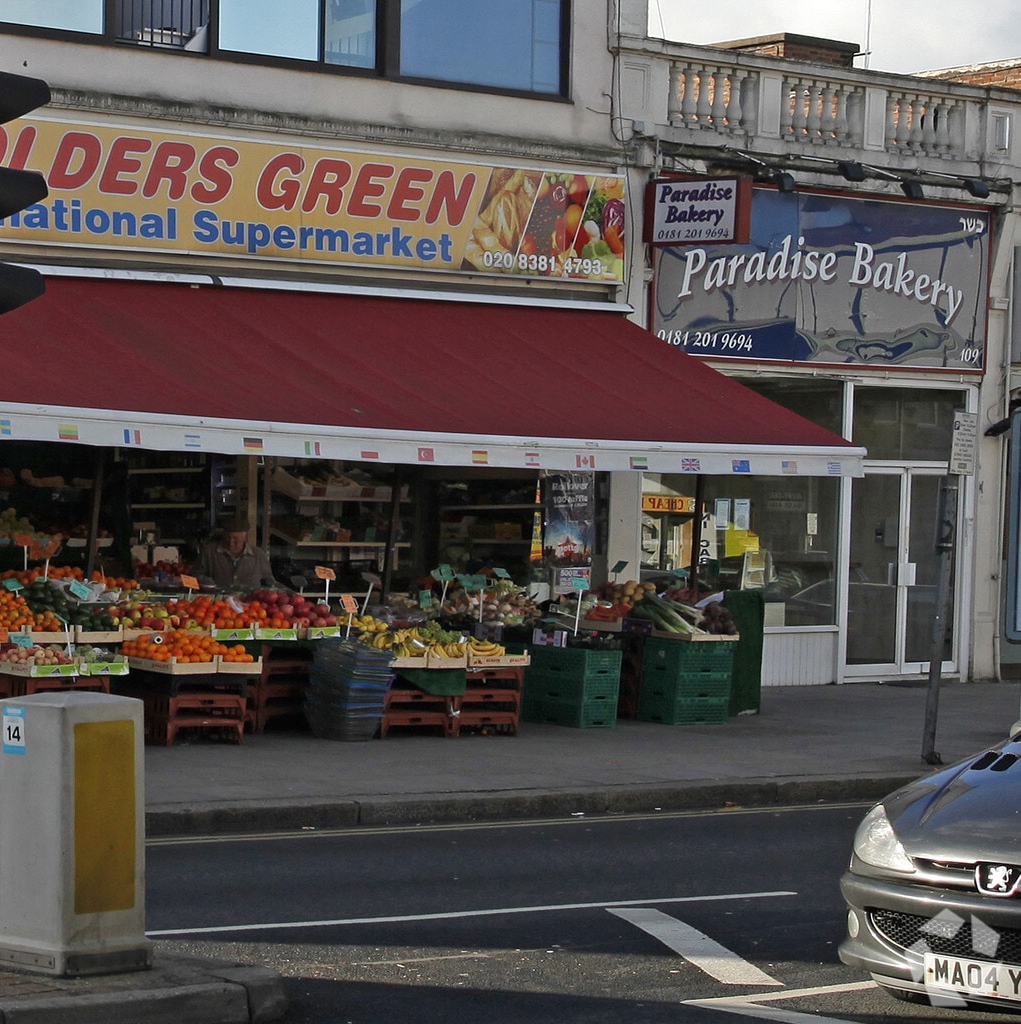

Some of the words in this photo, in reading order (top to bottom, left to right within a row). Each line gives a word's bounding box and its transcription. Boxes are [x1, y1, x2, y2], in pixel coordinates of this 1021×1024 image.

[256, 152, 476, 227] GREEN
[658, 183, 733, 204] Paradise
[664, 205, 725, 226] Bakery
[192, 209, 454, 264] Supermarket
[657, 228, 681, 240] 0181
[684, 228, 702, 240] 201
[703, 228, 729, 240] 9694
[482, 250, 513, 269] 020
[517, 253, 557, 273] 8381
[562, 256, 602, 276] 4793
[678, 235, 838, 299] Paradise
[849, 241, 964, 326] Bakery
[693, 331, 719, 347] 201
[720, 334, 753, 352] 9694
[959, 347, 979, 363] 109
[6, 725, 21, 742] 14
[934, 956, 1000, 991] MA04
